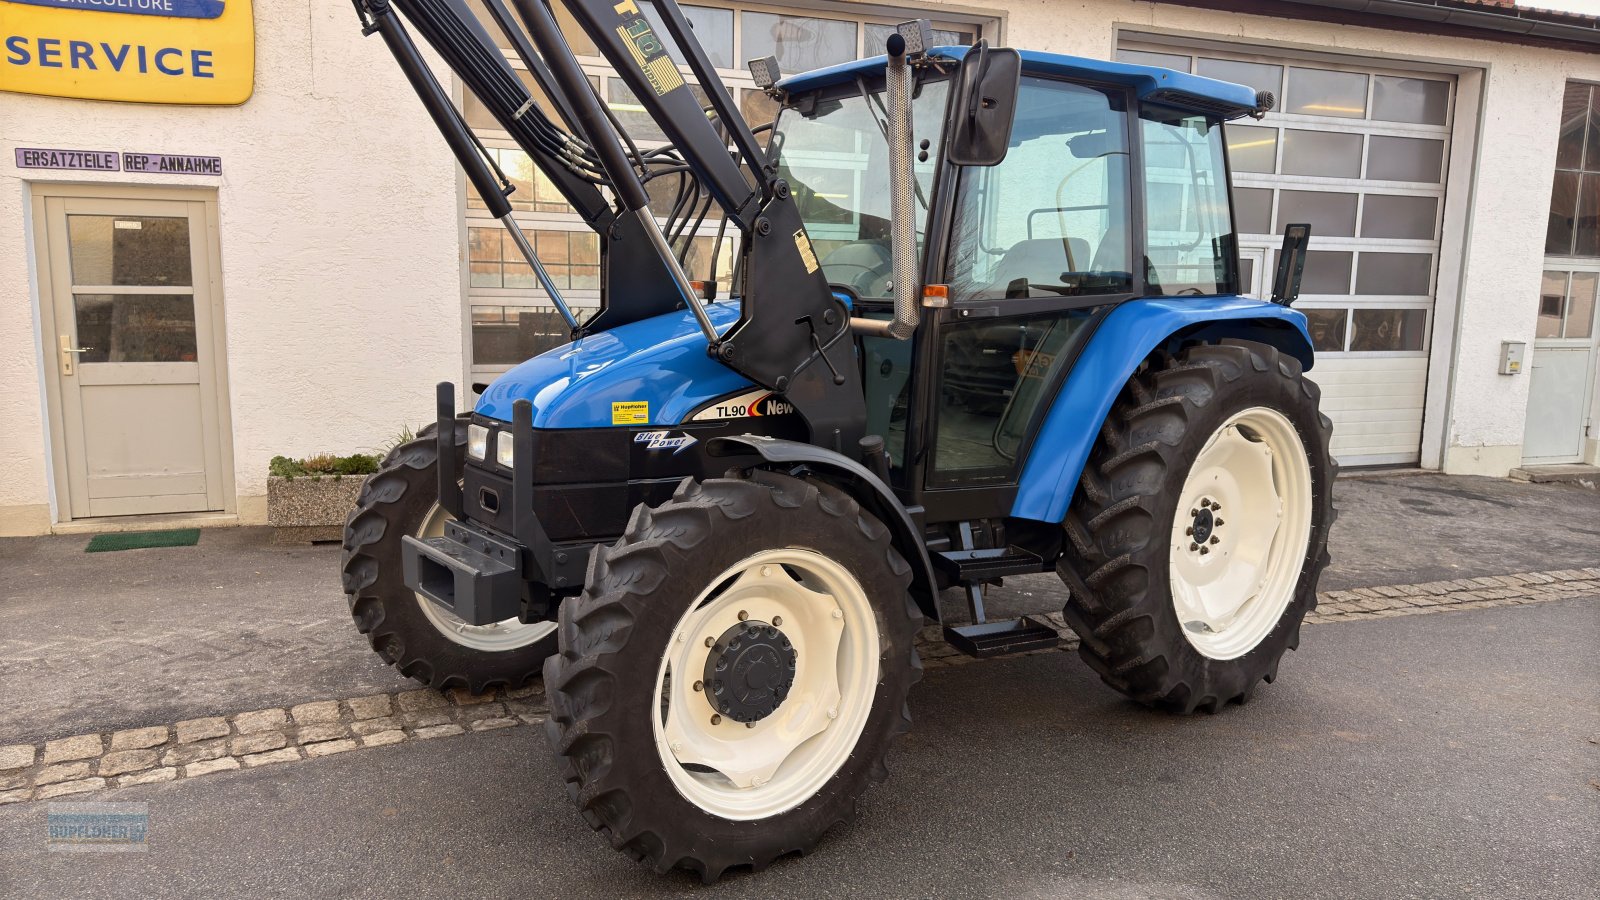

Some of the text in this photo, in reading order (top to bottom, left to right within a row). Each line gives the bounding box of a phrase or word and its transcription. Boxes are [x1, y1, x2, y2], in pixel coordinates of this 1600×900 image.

[53, 0, 173, 11] ULTURE
[5, 35, 215, 78] SERVICE
[24, 151, 113, 169] ERSATZTEILE
[716, 405, 746, 417] TL90
[766, 400, 794, 415] New
[636, 432, 662, 441] Blue
[650, 438, 687, 447] Power
